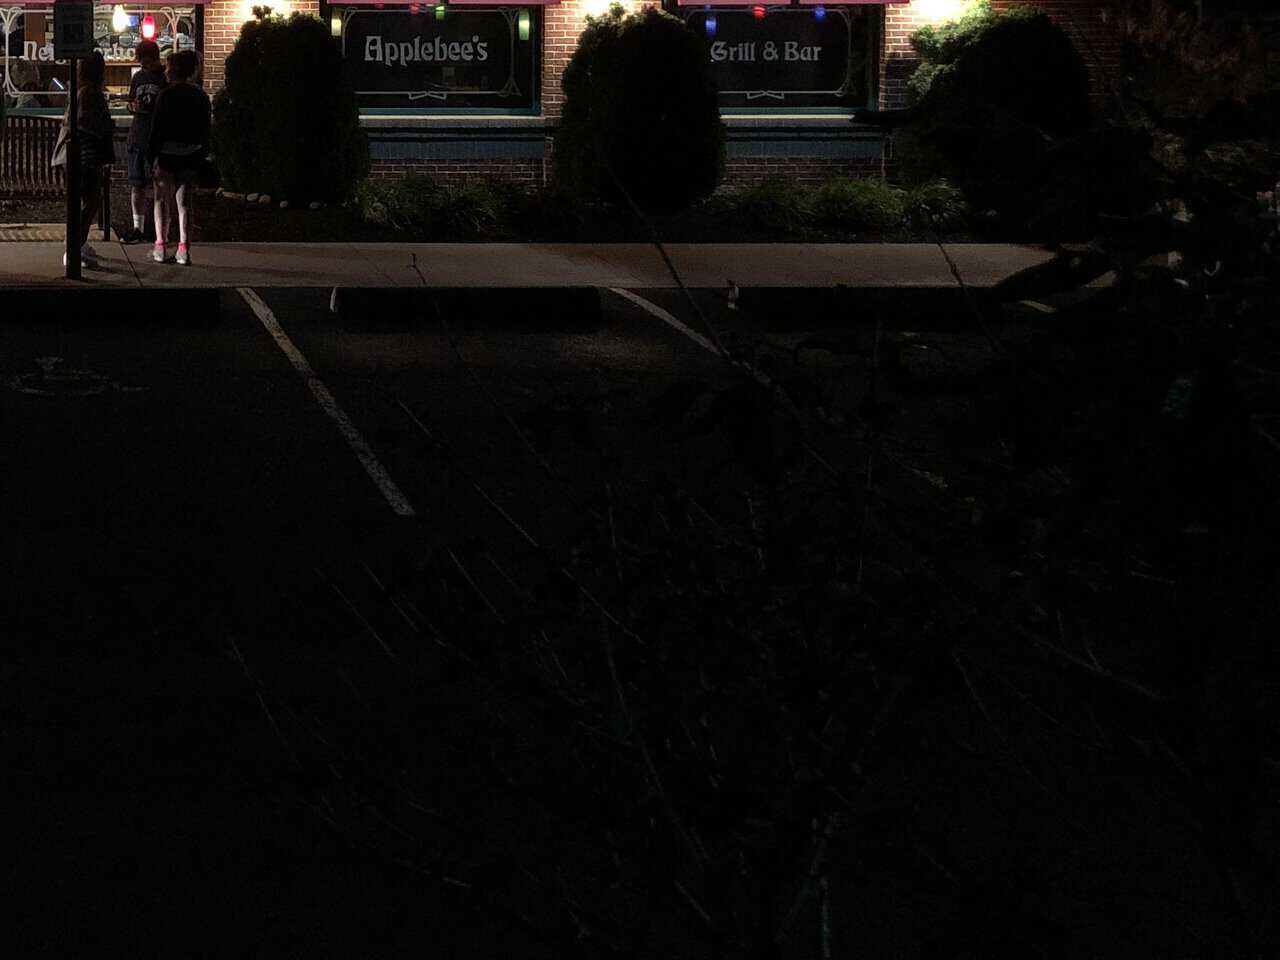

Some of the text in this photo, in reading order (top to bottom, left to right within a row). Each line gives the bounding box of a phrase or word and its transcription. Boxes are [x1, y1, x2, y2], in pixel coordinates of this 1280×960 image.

[364, 34, 488, 68] Applebee's
[710, 41, 822, 62] Grill & Bar
